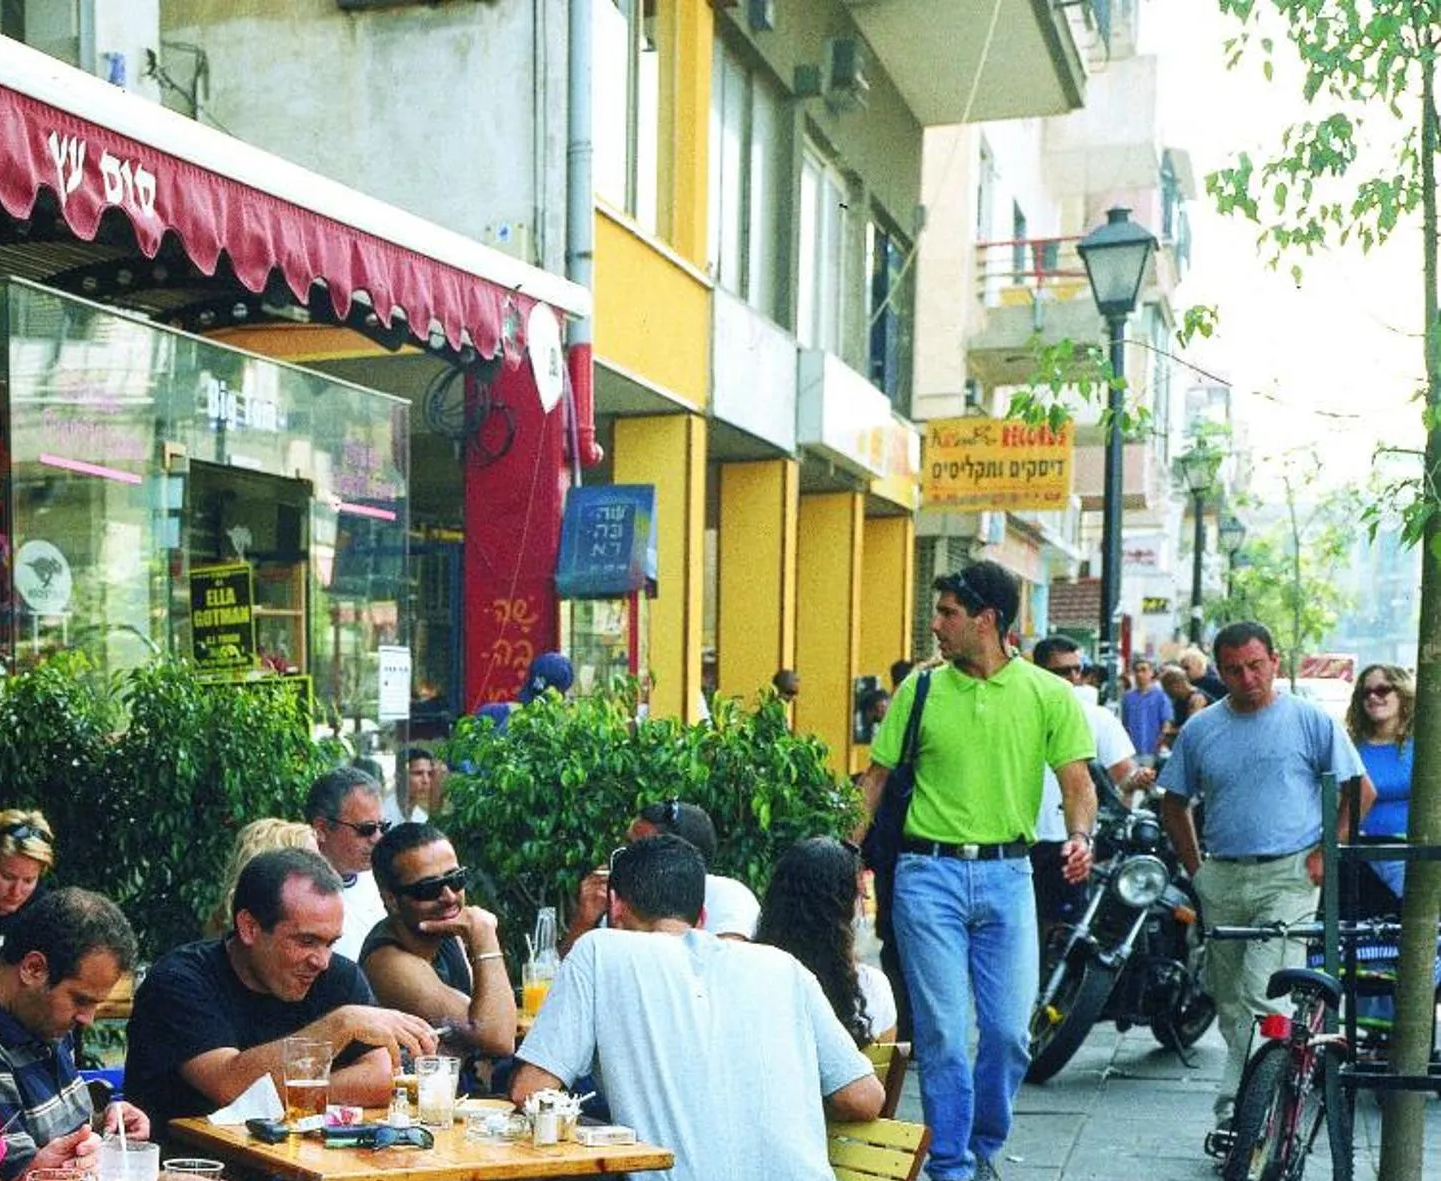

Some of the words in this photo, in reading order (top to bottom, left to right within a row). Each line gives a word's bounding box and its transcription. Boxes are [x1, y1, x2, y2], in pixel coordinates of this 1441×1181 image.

[48, 130, 86, 209] עץ
[99, 148, 156, 218] סוס
[932, 454, 1003, 485] ותקליטים
[1009, 459, 1063, 483] דיסקים
